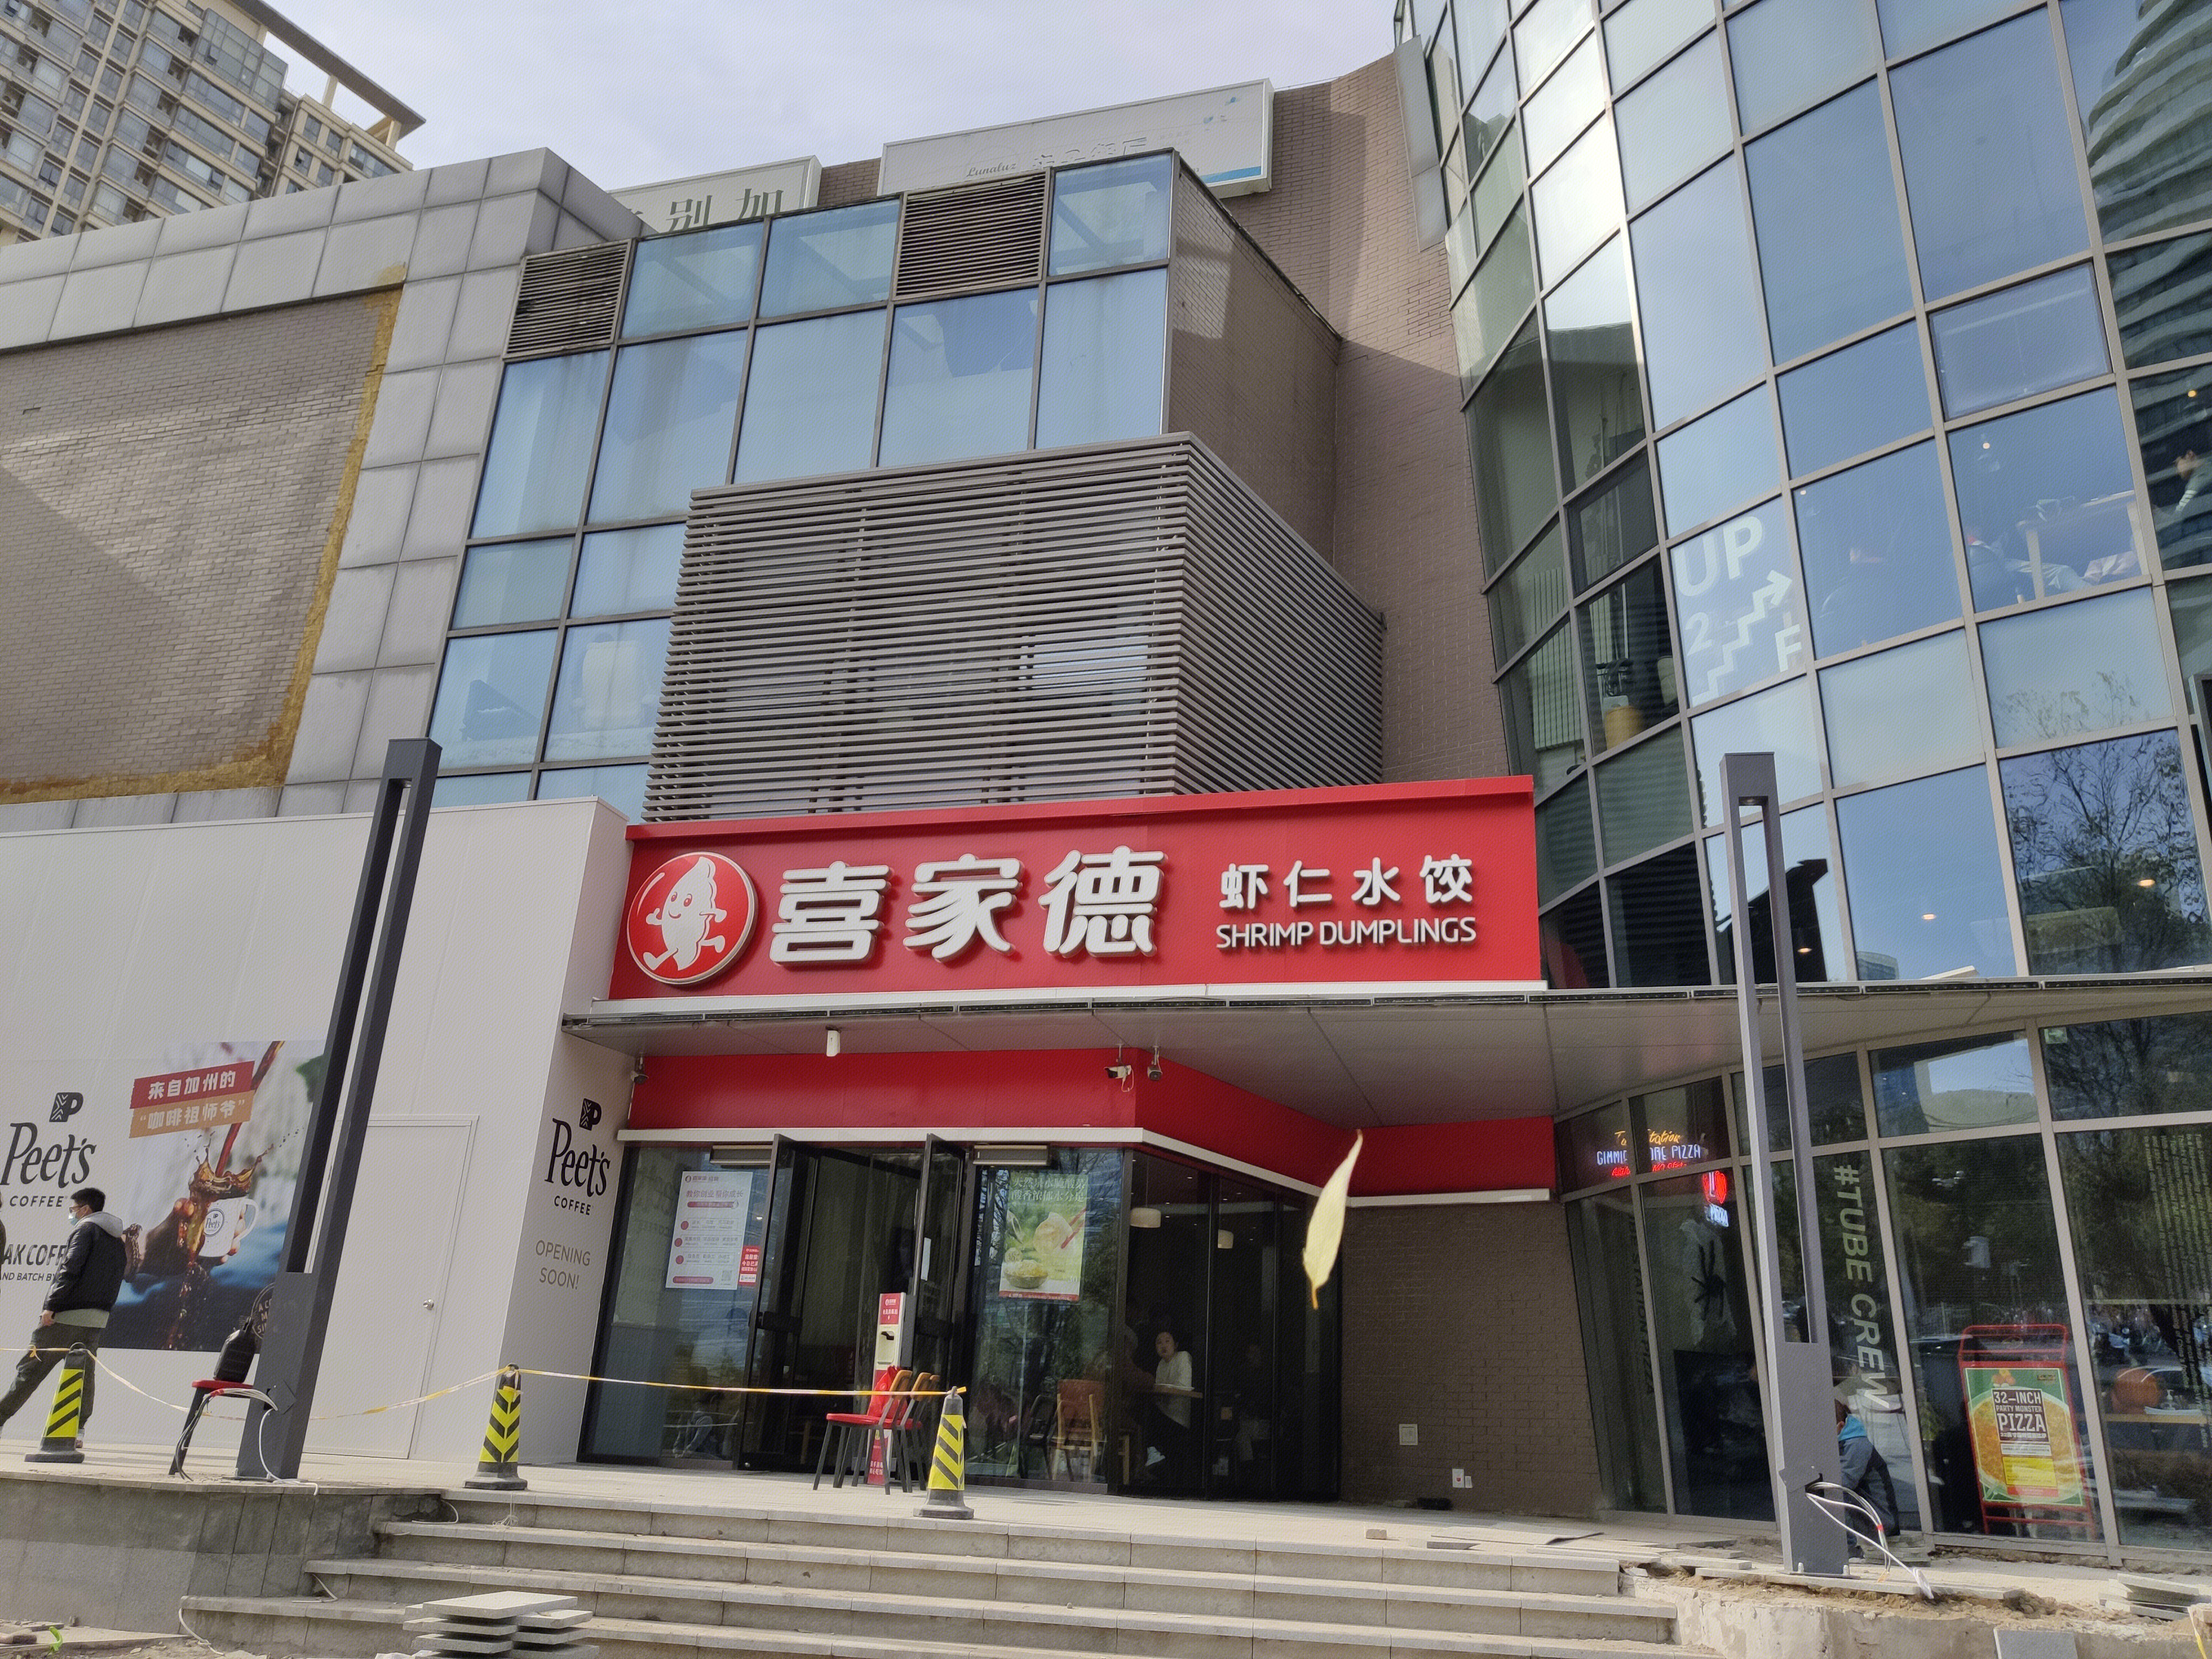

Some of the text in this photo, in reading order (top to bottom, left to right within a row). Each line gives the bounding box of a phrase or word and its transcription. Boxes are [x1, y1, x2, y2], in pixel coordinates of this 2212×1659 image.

[1672, 516, 1763, 597] UP
[1684, 612, 1802, 672] 2 F
[1218, 853, 1473, 909] 虾仁水饺
[769, 846, 1166, 964] 喜家德
[1215, 916, 1477, 949] SHRIMP DUMPLINGS
[147, 1070, 236, 1100] 来自加州的
[0, 1122, 97, 1188] Peet's
[544, 1118, 611, 1197] Peet's
[9, 1196, 64, 1207] COFFEE
[554, 1195, 591, 1215] COFFEE
[2, 1244, 68, 1266] AK COFF
[535, 1239, 591, 1266] OPENING
[1, 1272, 14, 1281] ND
[17, 1272, 44, 1281] BATCH
[539, 1267, 580, 1290] SOON!
[1833, 1164, 1891, 1409] #TUBE CREW
[1993, 1391, 2042, 1405] 32-INCH
[1997, 1413, 2046, 1432] PIZZA
